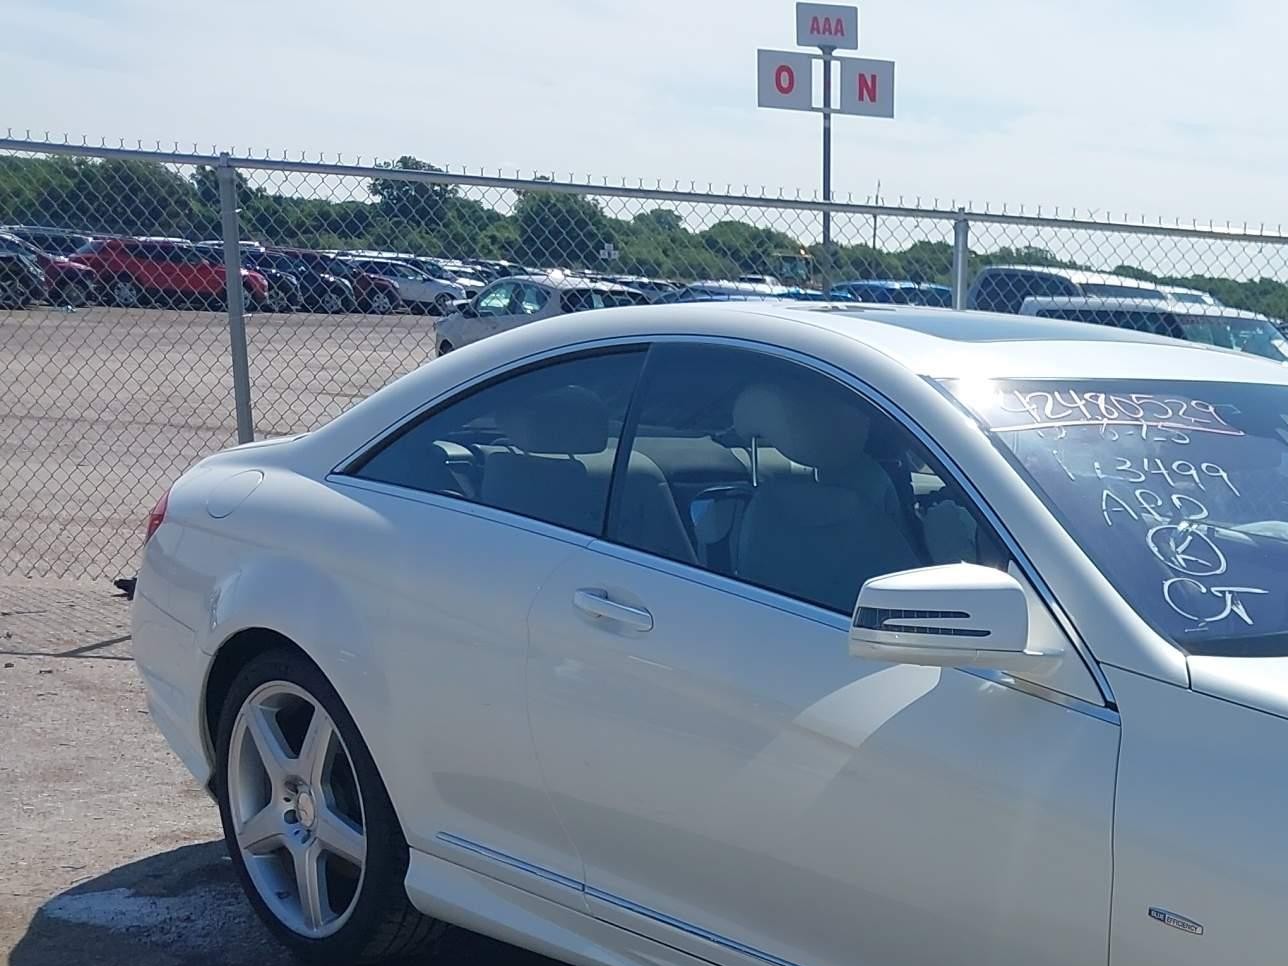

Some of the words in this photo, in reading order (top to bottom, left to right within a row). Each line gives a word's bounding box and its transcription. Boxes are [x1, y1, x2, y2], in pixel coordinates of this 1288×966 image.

[810, 16, 845, 37] AAA
[775, 65, 795, 94] O
[858, 73, 877, 103] N
[1000, 388, 1228, 427] 42480529
